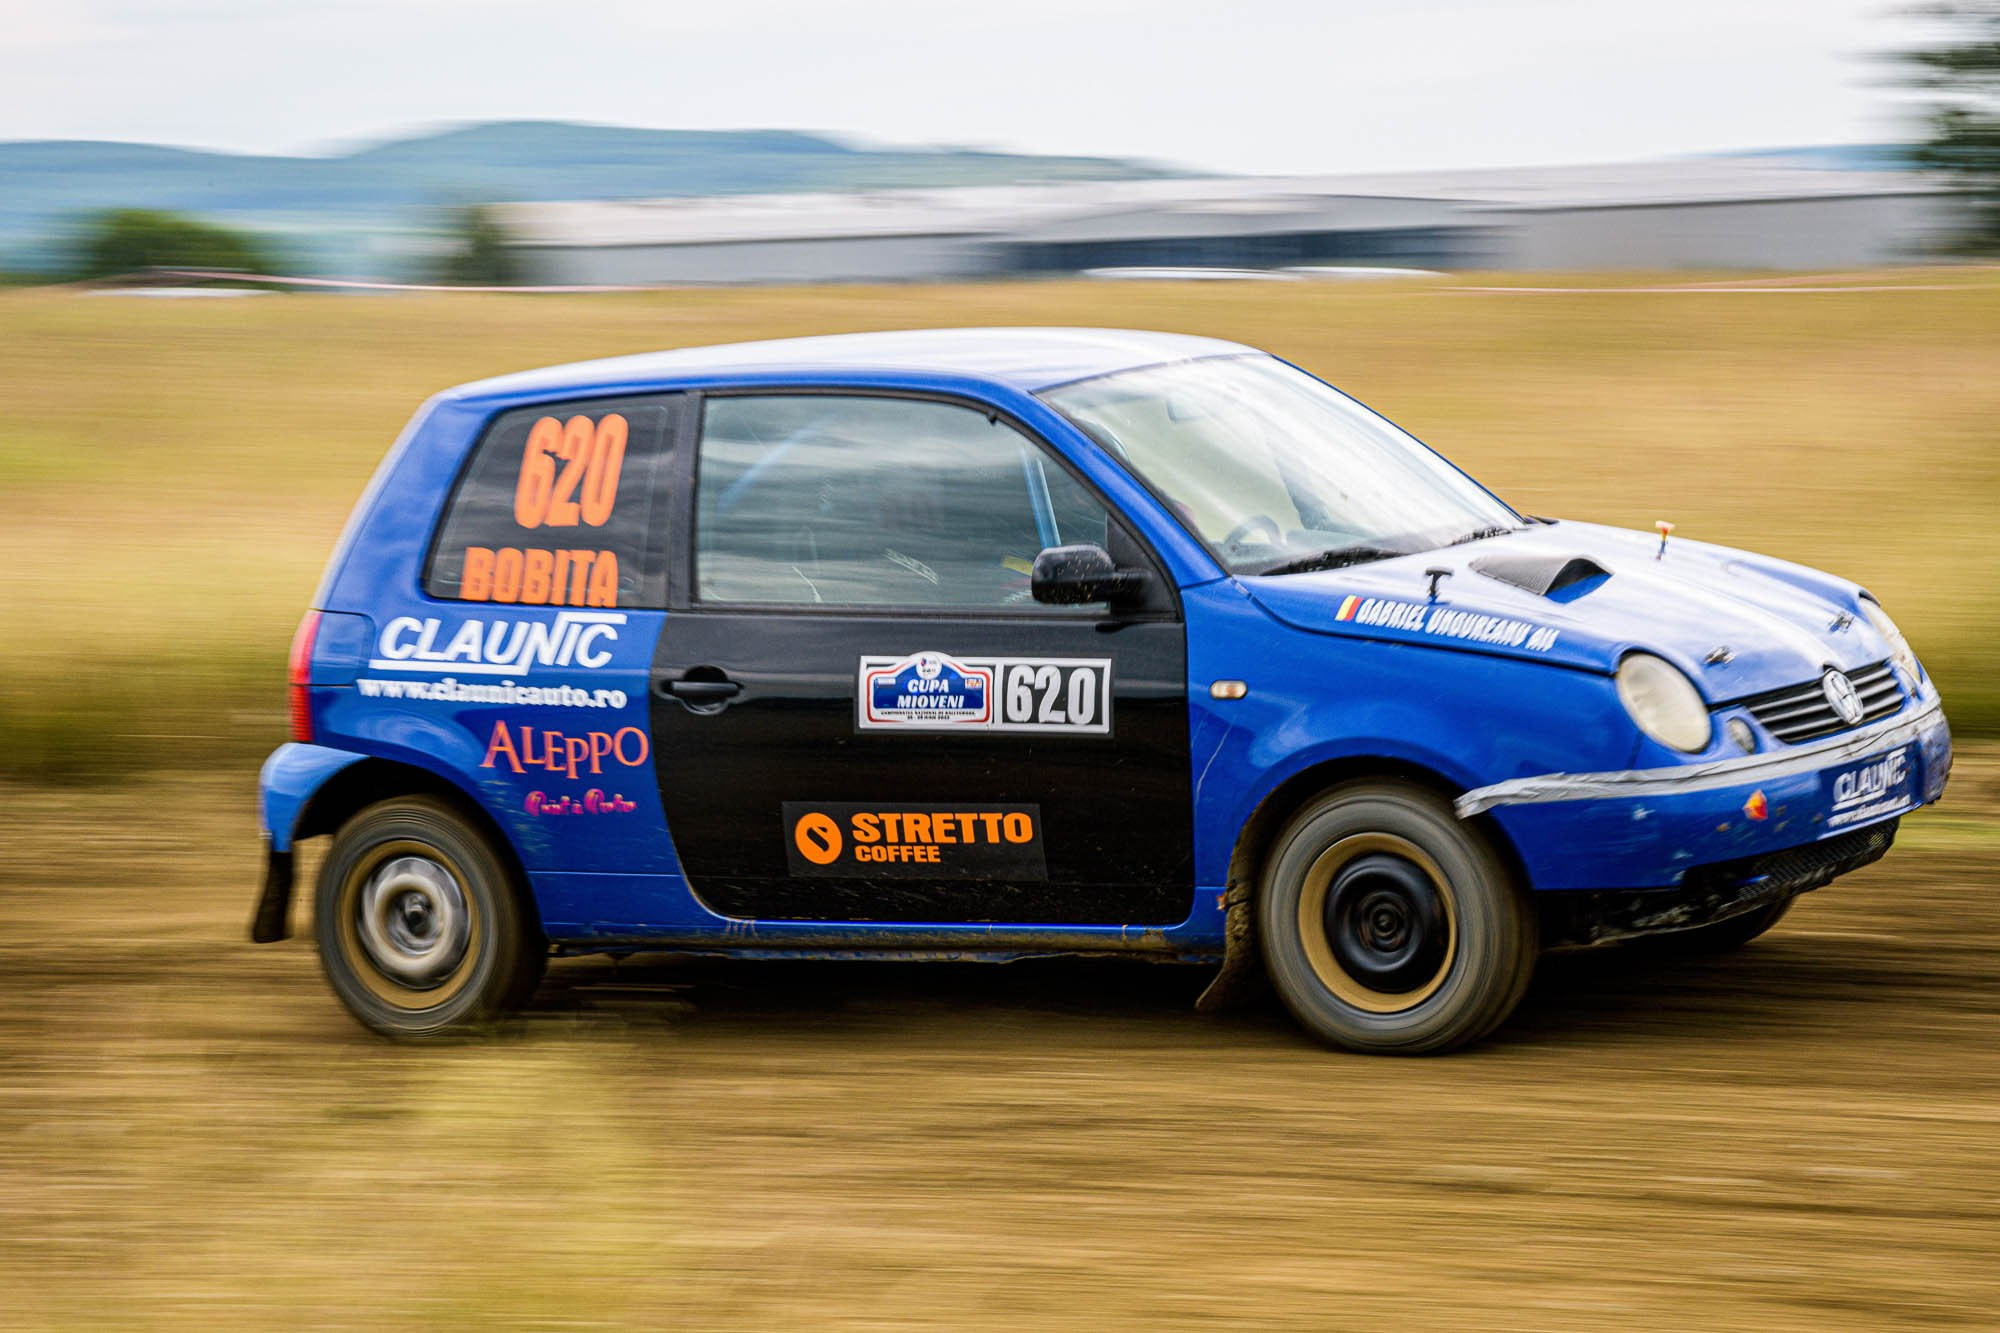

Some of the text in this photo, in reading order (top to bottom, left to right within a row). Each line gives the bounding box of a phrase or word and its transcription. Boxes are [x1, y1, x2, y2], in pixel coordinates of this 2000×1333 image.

[514, 413, 629, 529] 620
[459, 546, 619, 608] BOBITA
[1355, 598, 1429, 632] GABRIEL
[370, 612, 628, 676] CLAUNIC
[896, 694, 965, 709] MIOVENI
[907, 678, 950, 694] CUPA
[1006, 664, 1096, 725] 620
[479, 720, 649, 779] ALEPPO
[851, 812, 1034, 844] STRETTO
[854, 845, 942, 863] COFFEE
